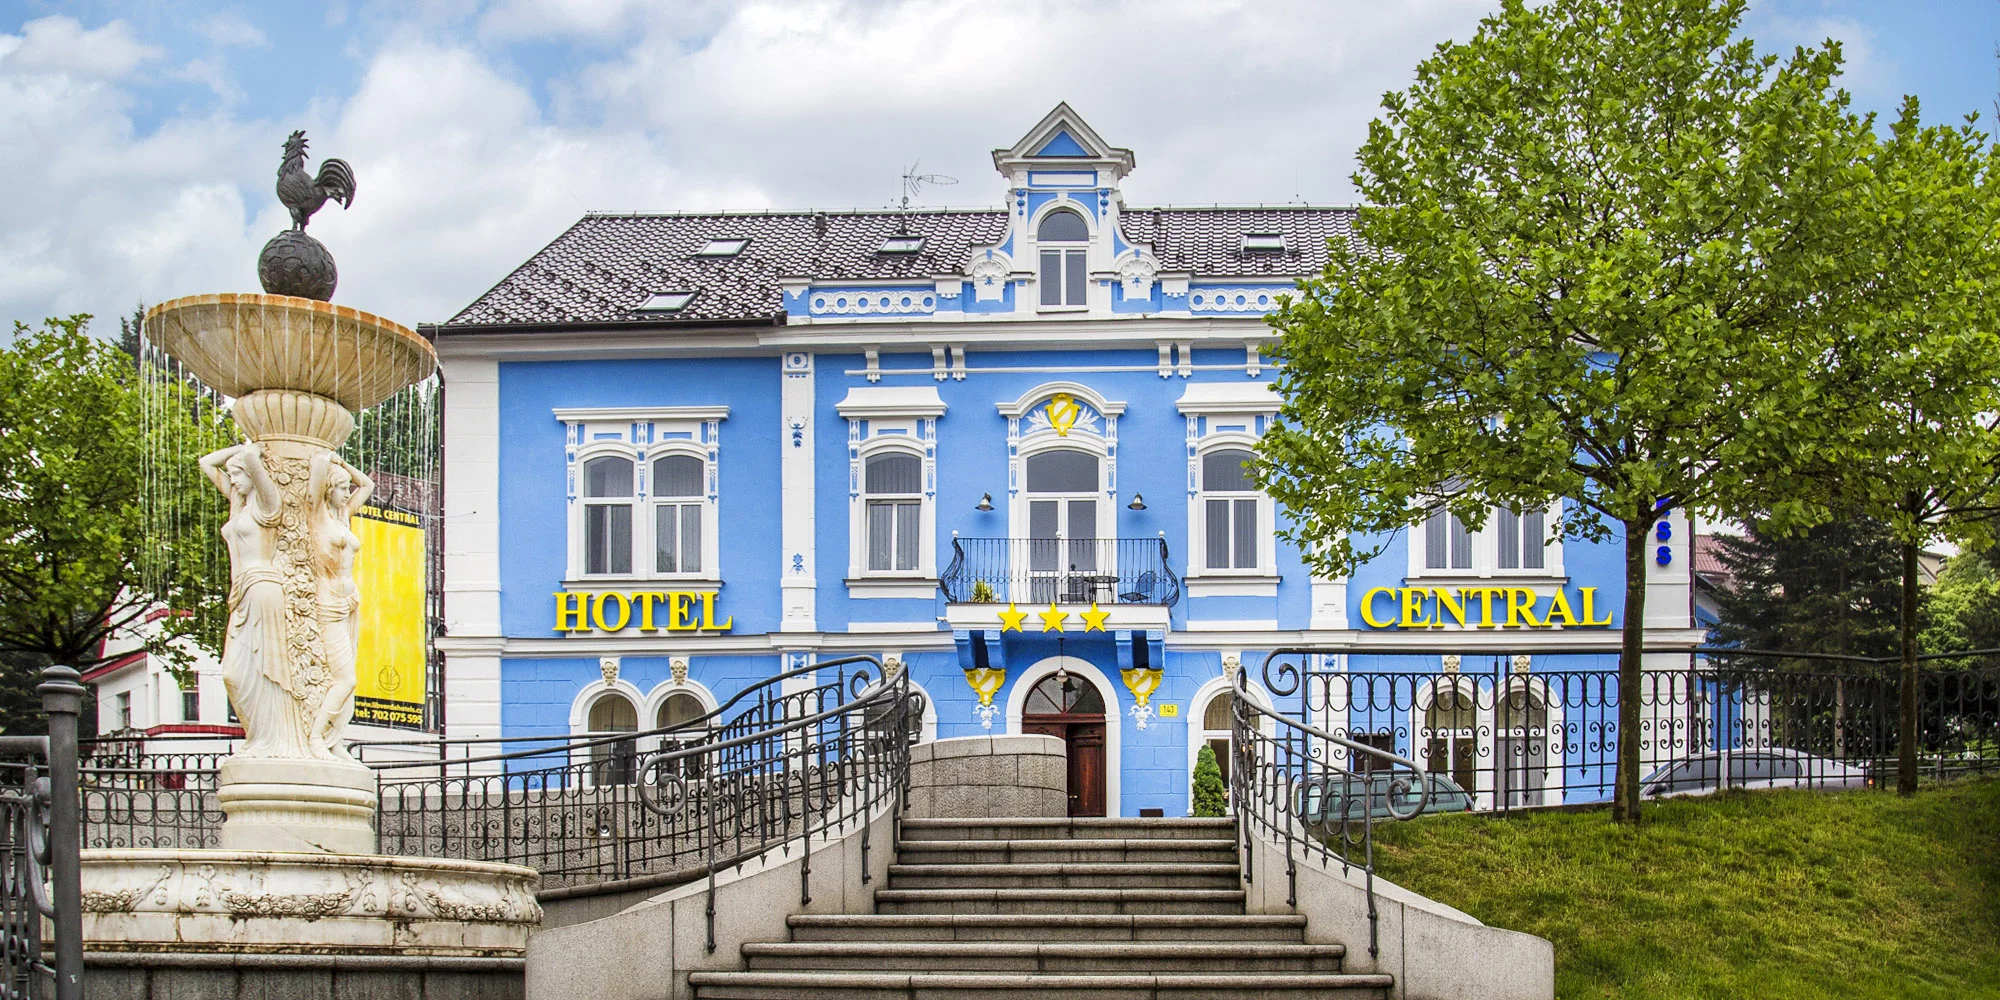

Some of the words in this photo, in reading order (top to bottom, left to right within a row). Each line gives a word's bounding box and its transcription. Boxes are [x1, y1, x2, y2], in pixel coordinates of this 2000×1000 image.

[383, 509, 420, 525] CENTRAL
[552, 591, 733, 632] HOTEL
[1360, 586, 1613, 628] CENTRAL
[355, 708, 370, 718] tel:
[372, 710, 389, 721] 702
[389, 712, 406, 722] 075
[407, 714, 423, 724] 595
